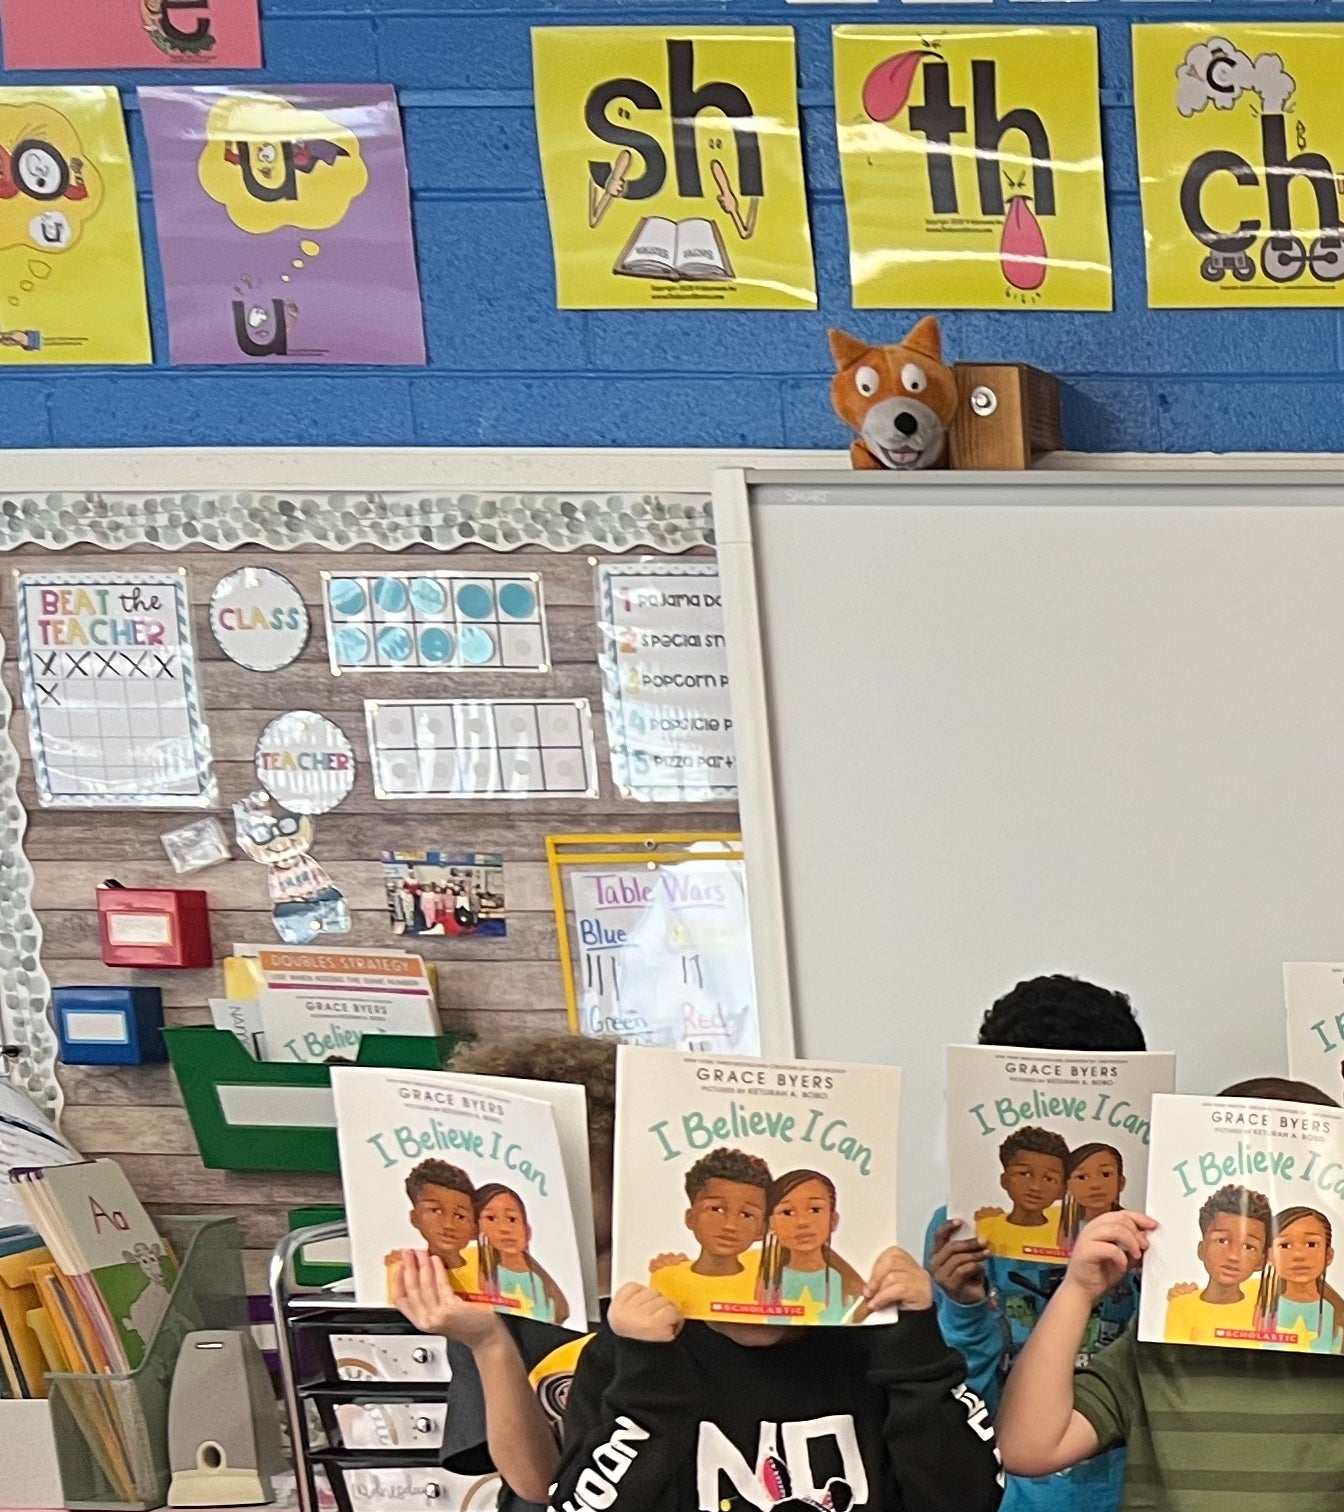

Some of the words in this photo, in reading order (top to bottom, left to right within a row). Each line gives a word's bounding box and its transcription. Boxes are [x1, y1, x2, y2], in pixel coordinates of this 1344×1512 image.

[584, 39, 764, 200] sh
[909, 59, 1056, 216] th
[239, 141, 297, 201] u
[1180, 114, 1342, 251] ch
[41, 590, 108, 616] BEAT
[119, 587, 162, 613] the
[38, 619, 165, 645] TEACHER
[219, 608, 298, 631] CLASS
[262, 752, 349, 771] TEACHER
[584, 875, 652, 904] Table
[580, 919, 628, 945] Blue
[269, 954, 334, 971] DOUBLES
[338, 957, 409, 973] STRATEGY
[305, 1001, 348, 1014] GRACE
[352, 1002, 388, 1015] BYERS
[696, 1067, 766, 1086] GRACE
[777, 1073, 835, 1090] BYERS
[648, 1120, 682, 1162] I
[682, 1101, 795, 1149] Believe
[801, 1108, 824, 1142] I
[821, 1118, 874, 1176] Can
[89, 1195, 131, 1235] Aa
[722, 1304, 803, 1316] SCHOLASTIC
[698, 1415, 869, 1512] NO
